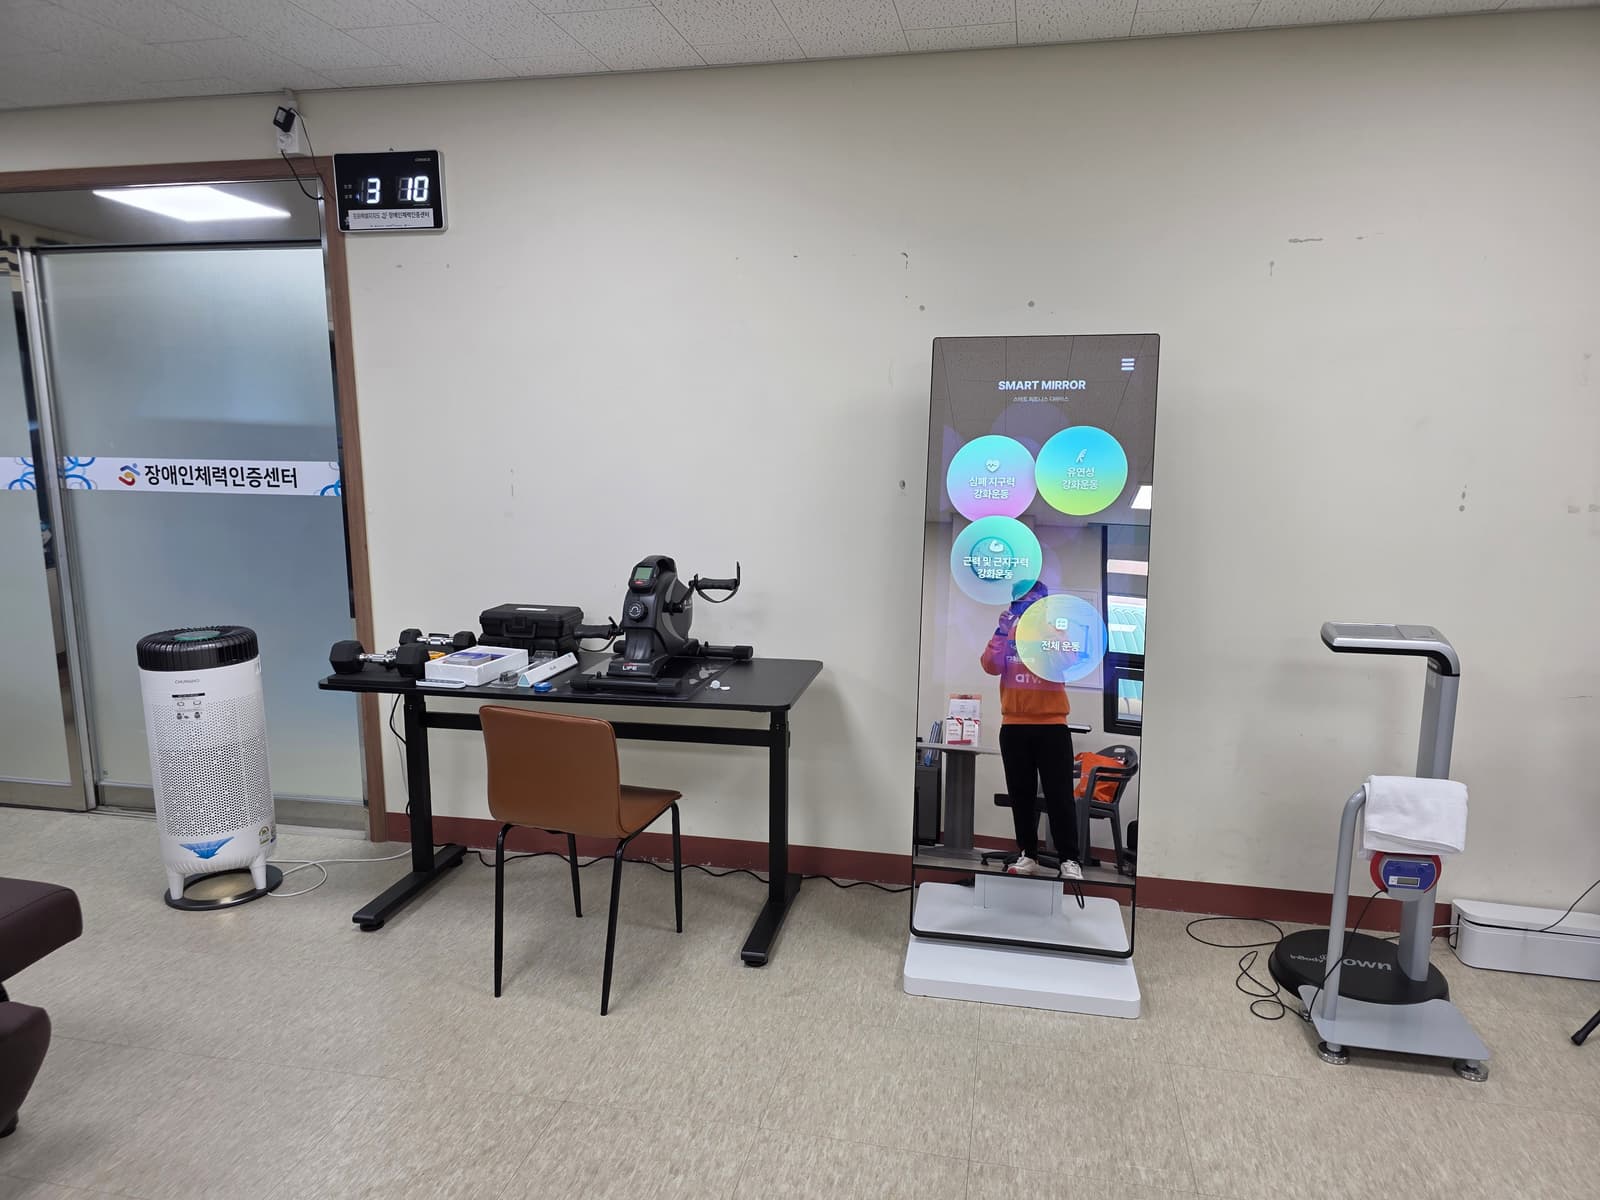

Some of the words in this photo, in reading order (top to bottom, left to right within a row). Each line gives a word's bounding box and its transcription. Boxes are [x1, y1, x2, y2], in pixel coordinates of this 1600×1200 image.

[366, 177, 381, 204] 3
[407, 175, 430, 202] 10
[998, 380, 1040, 390] SMART
[1041, 380, 1086, 390] MIRROR
[144, 464, 298, 488] 장애인체력인증센터
[1066, 467, 1095, 478] 유연성
[969, 476, 987, 487] 심폐
[988, 476, 1016, 487] 지구력
[1062, 479, 1098, 490] 강화운동
[974, 488, 1009, 499] 강화운동
[963, 556, 981, 567] 근력
[982, 556, 992, 567] 및
[993, 556, 1029, 568] 근지구력
[977, 568, 1014, 580] 강화운동
[1041, 640, 1060, 652] 전체
[1061, 641, 1080, 652] 운동
[1341, 958, 1392, 971] own
